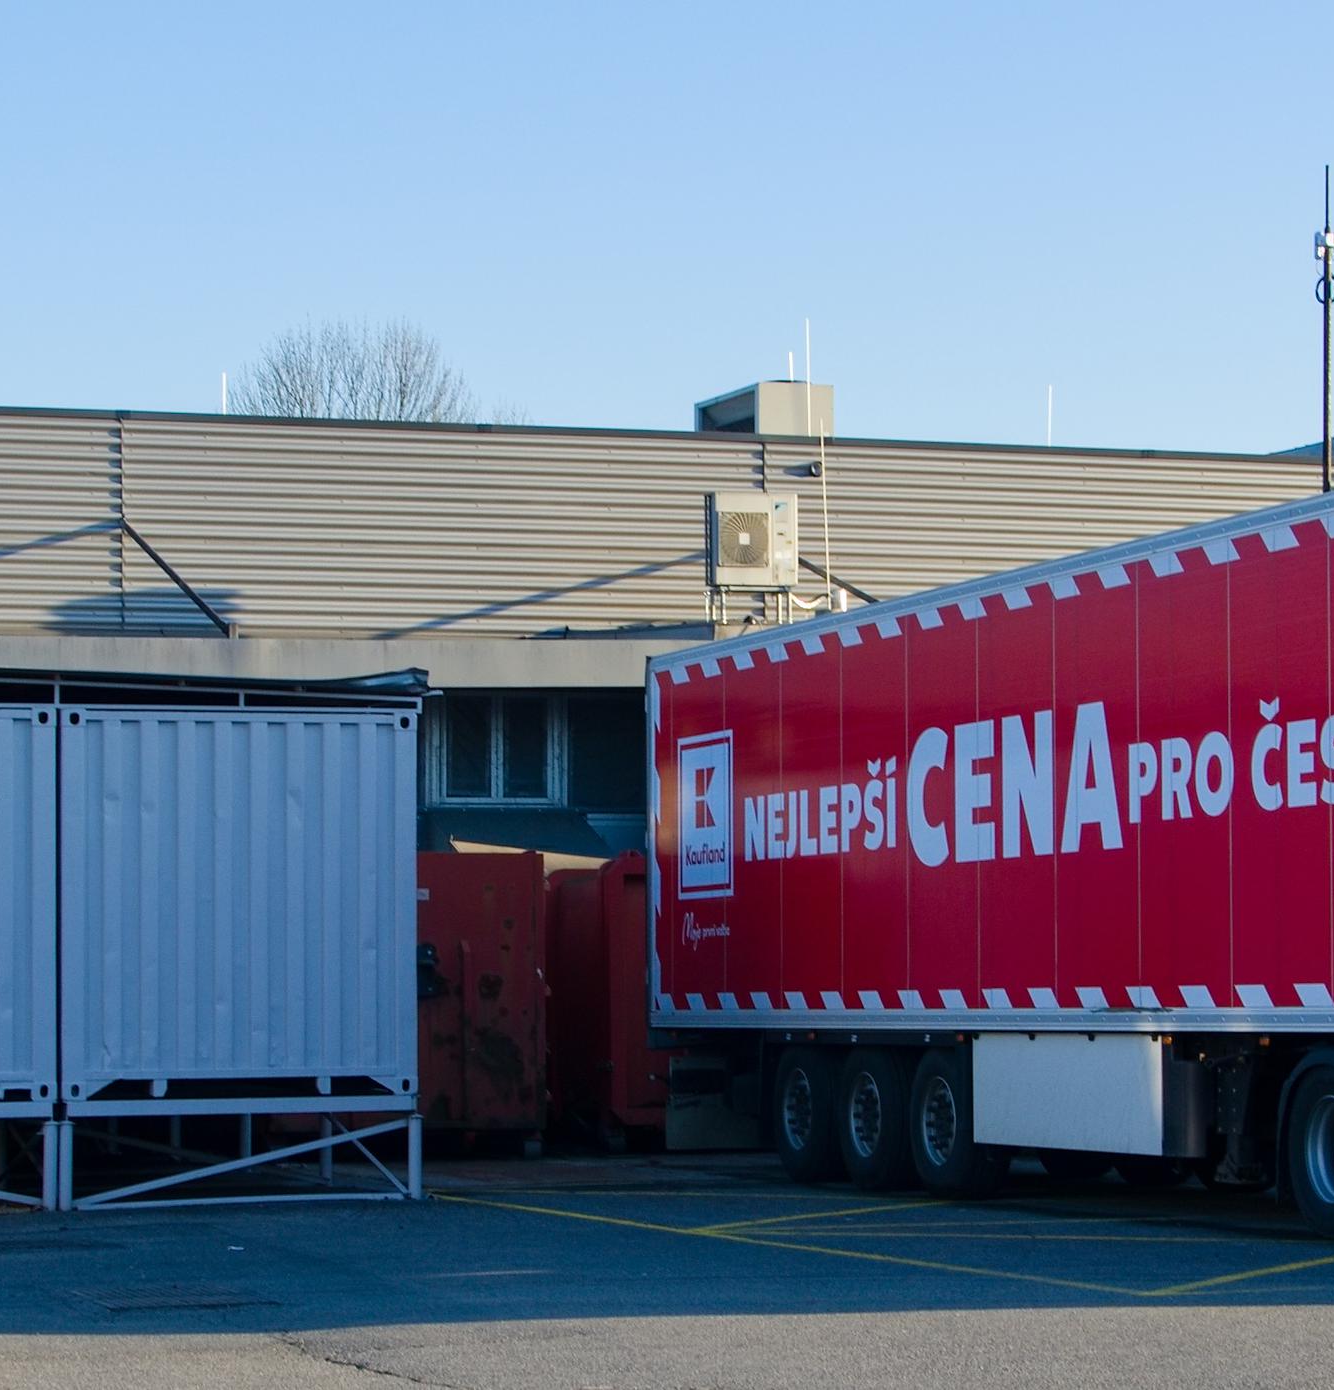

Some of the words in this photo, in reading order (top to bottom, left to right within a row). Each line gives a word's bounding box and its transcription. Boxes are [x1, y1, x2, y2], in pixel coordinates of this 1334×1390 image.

[744, 756, 897, 862] NEJLEPŠÍ
[906, 700, 1124, 867] CENA
[1128, 731, 1234, 824] PRO
[685, 841, 726, 867] Kaufland
